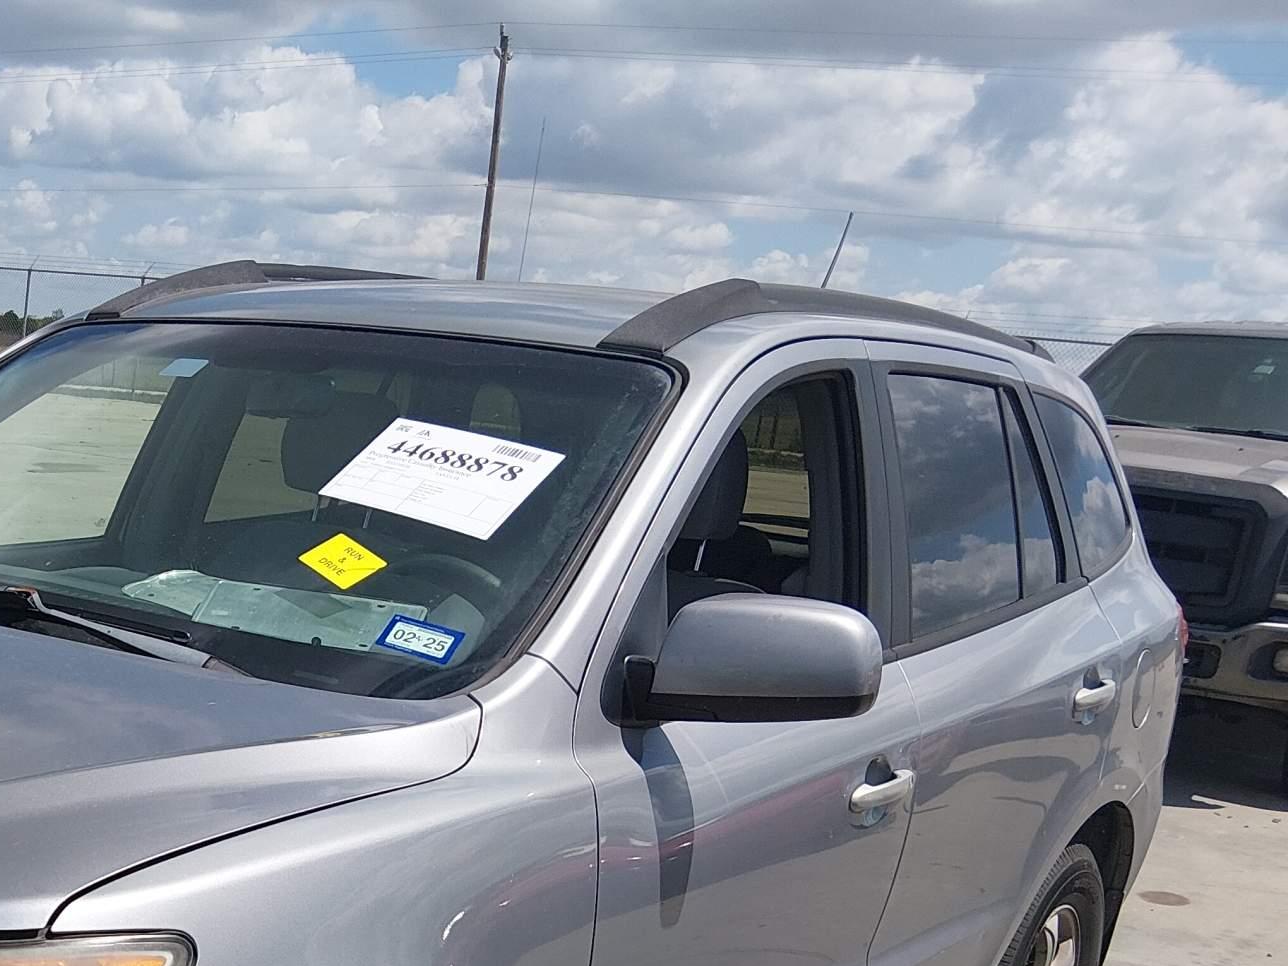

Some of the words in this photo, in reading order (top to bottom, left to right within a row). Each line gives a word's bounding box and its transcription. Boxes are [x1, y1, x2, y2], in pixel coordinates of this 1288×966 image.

[387, 440, 524, 482] 44688878
[344, 546, 365, 561] RUN
[318, 556, 347, 577] DRIVE
[393, 629, 417, 643] 02
[422, 637, 449, 652] 25
